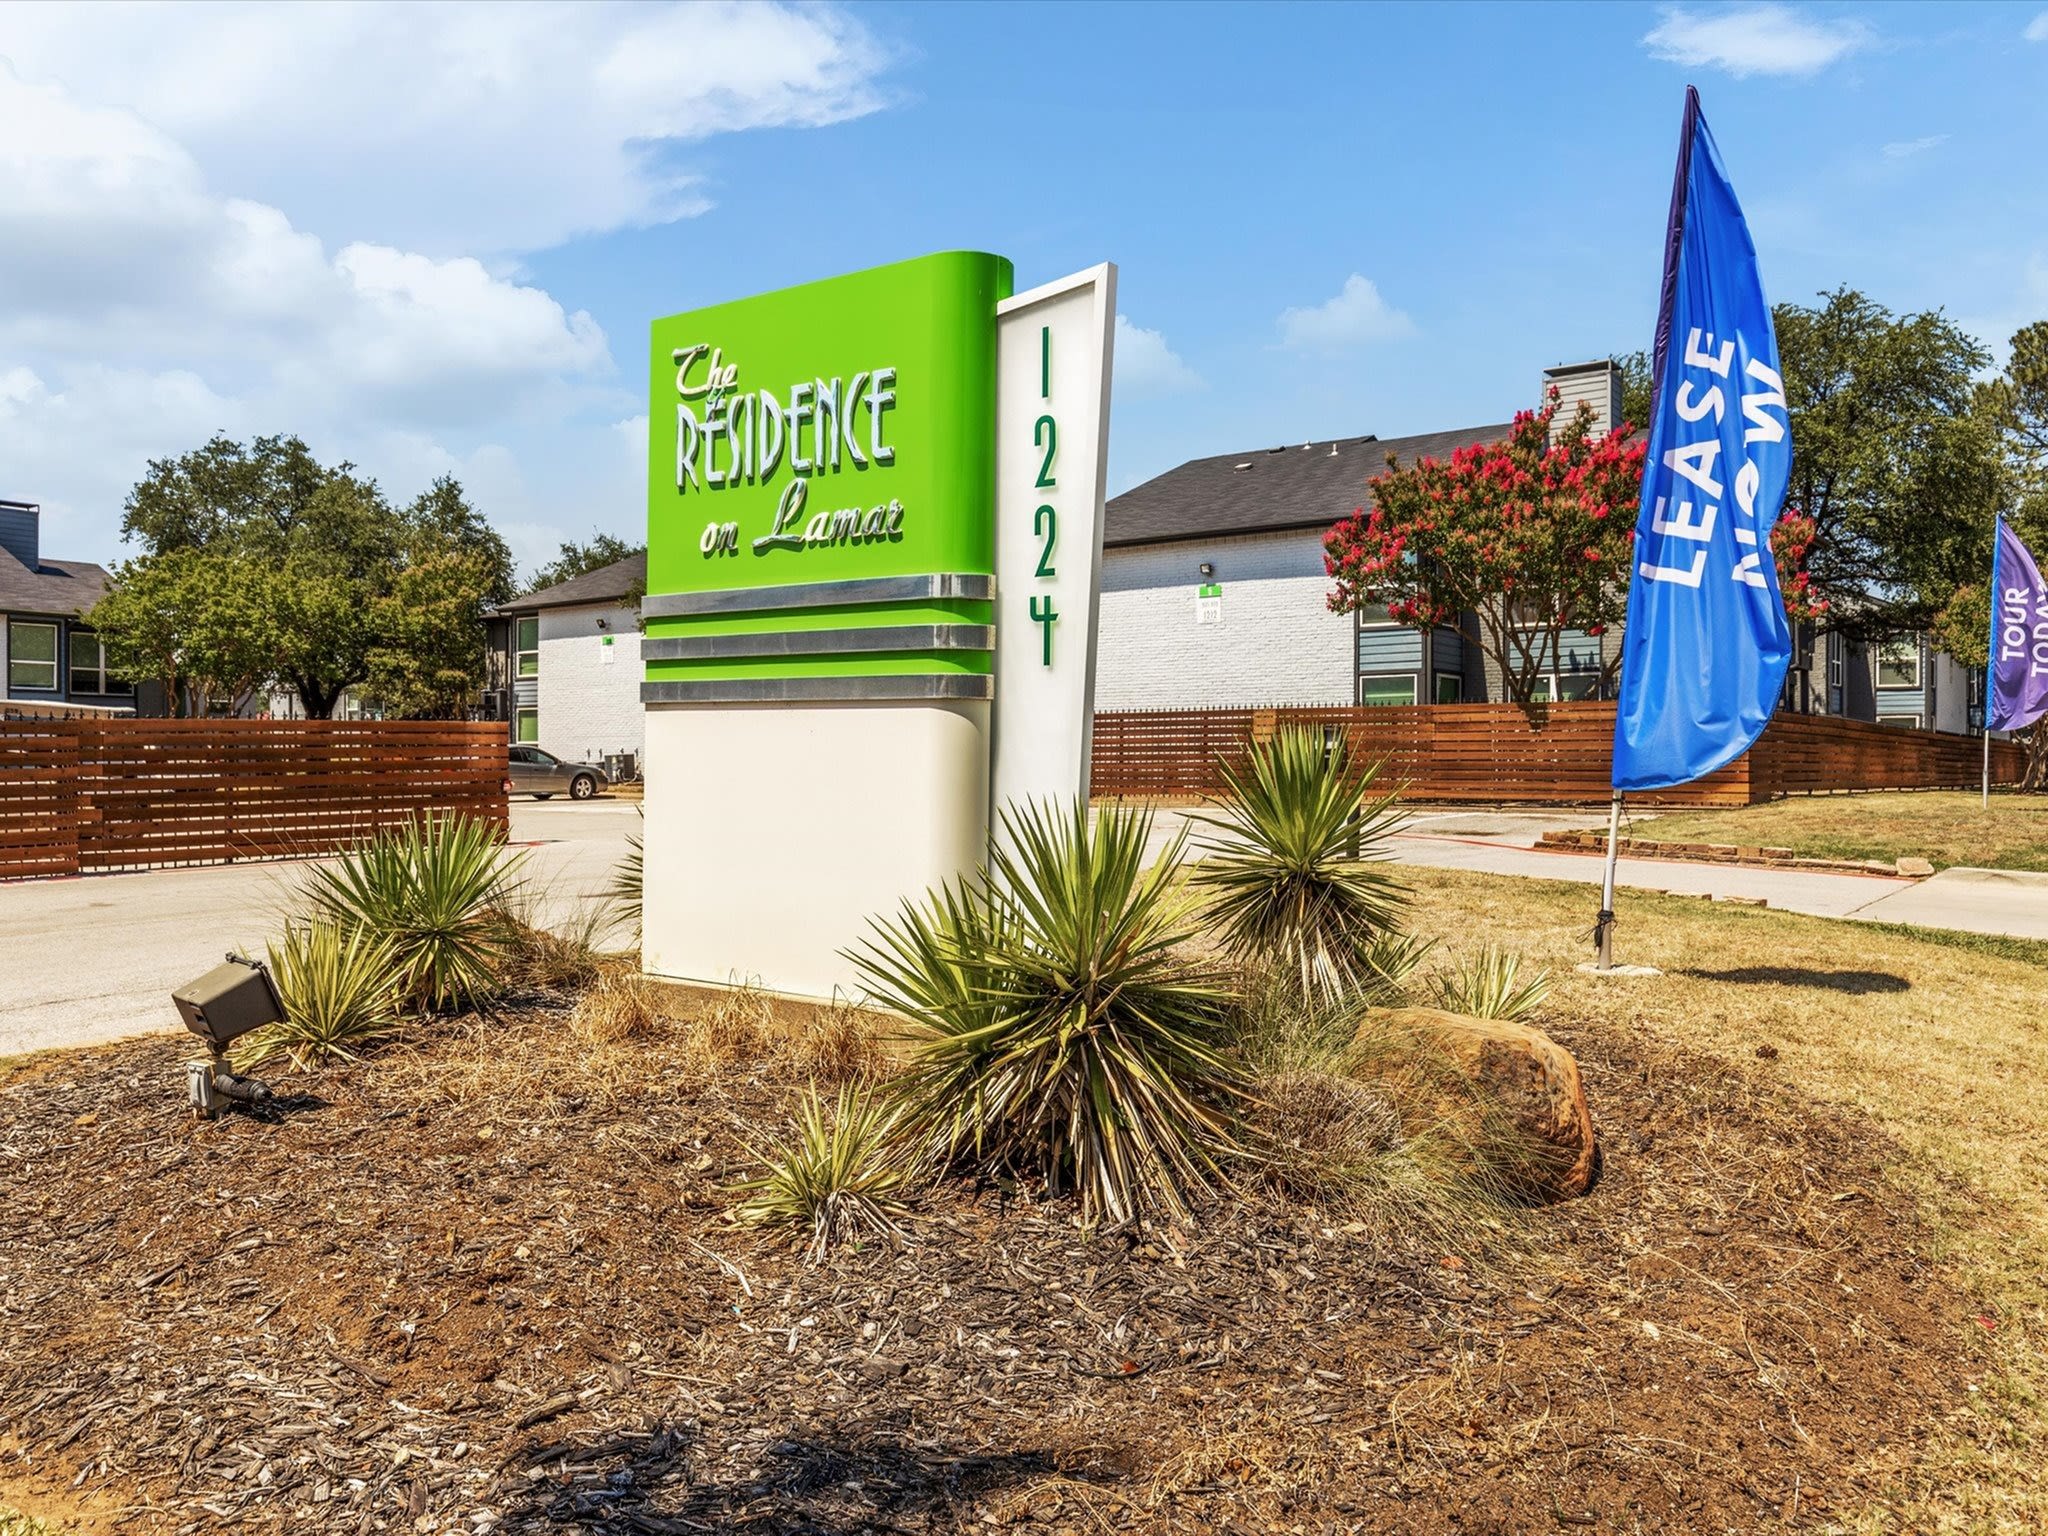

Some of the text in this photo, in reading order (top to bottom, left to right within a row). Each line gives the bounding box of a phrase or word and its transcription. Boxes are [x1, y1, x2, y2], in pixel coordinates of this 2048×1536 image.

[672, 343, 737, 396] The
[676, 367, 896, 491] RESIDENCE
[1639, 327, 1735, 589] LEASE
[700, 477, 904, 553] on Lamar
[1029, 326, 1058, 666] 1224
[2002, 587, 2030, 662] TOUR
